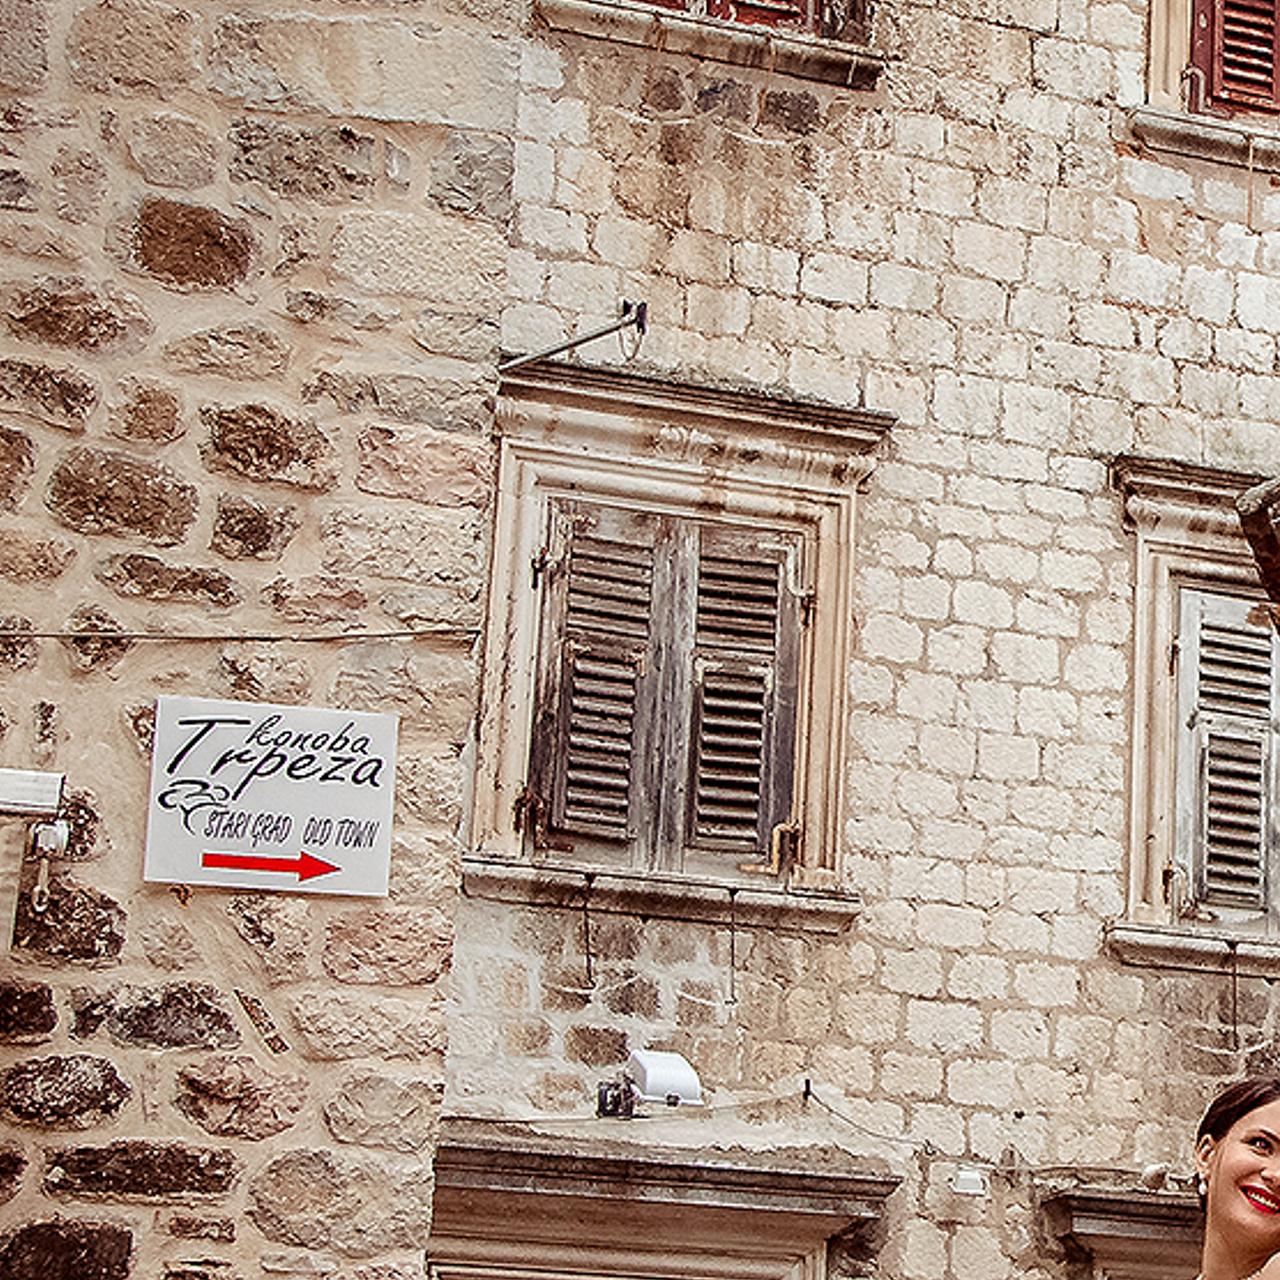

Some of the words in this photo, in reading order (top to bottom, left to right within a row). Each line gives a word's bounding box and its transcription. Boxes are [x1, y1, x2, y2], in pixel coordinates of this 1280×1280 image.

[166, 718, 384, 801] Trpeza
[203, 810, 251, 838] STARI
[252, 813, 293, 847] GRAD
[303, 817, 333, 846] OLD
[335, 818, 380, 847] TOWN
